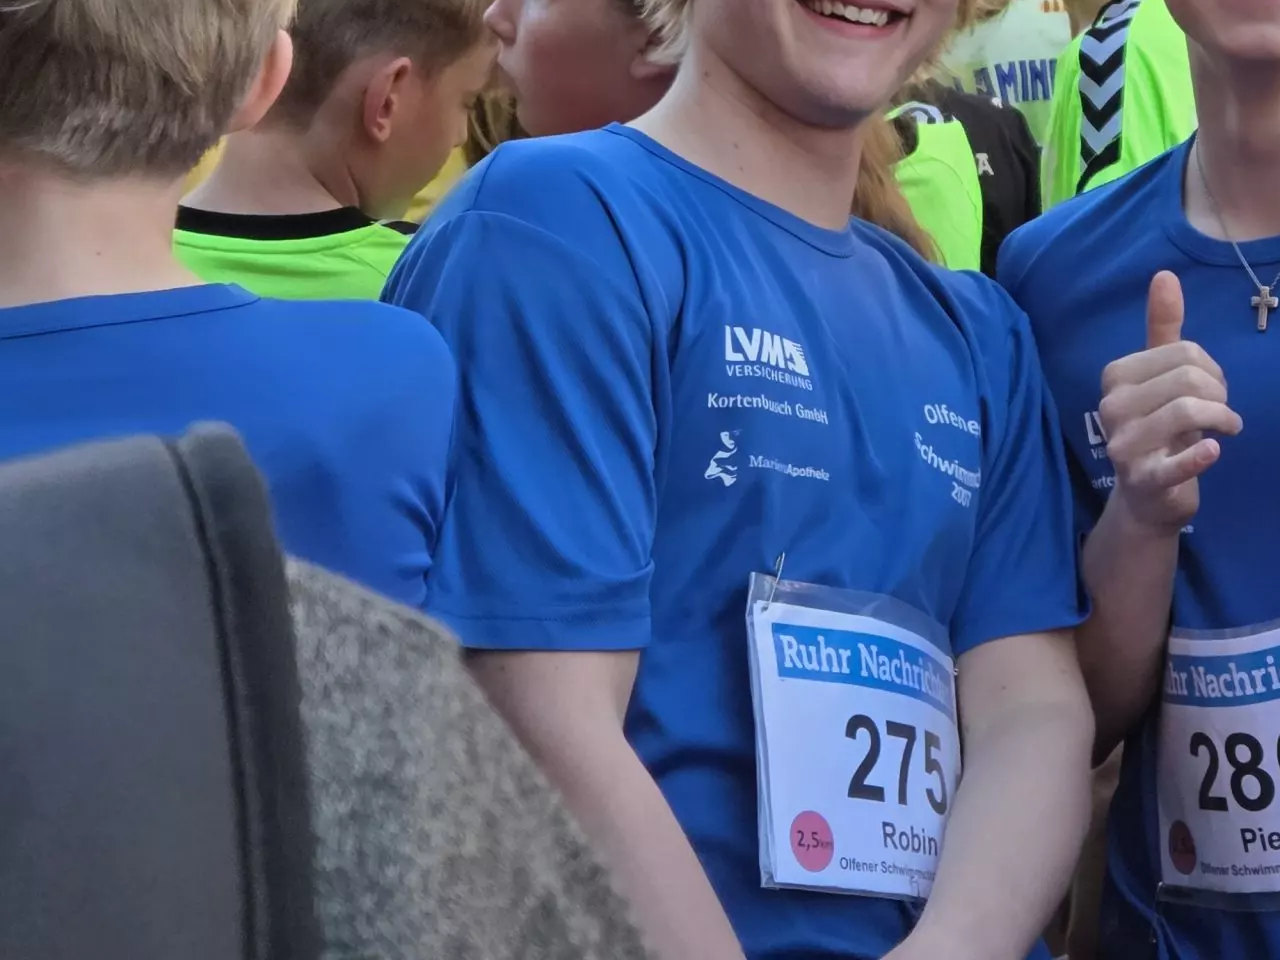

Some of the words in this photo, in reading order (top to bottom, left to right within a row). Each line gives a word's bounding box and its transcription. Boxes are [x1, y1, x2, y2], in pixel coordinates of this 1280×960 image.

[725, 325, 785, 369] LVM
[726, 364, 813, 391] VERSICHERUNG
[795, 403, 829, 425] GmbH
[951, 481, 972, 508] 2007
[779, 634, 851, 674] Ruhr
[845, 713, 949, 816] 275
[882, 820, 938, 856] Robin
[839, 856, 879, 872] Olfener
